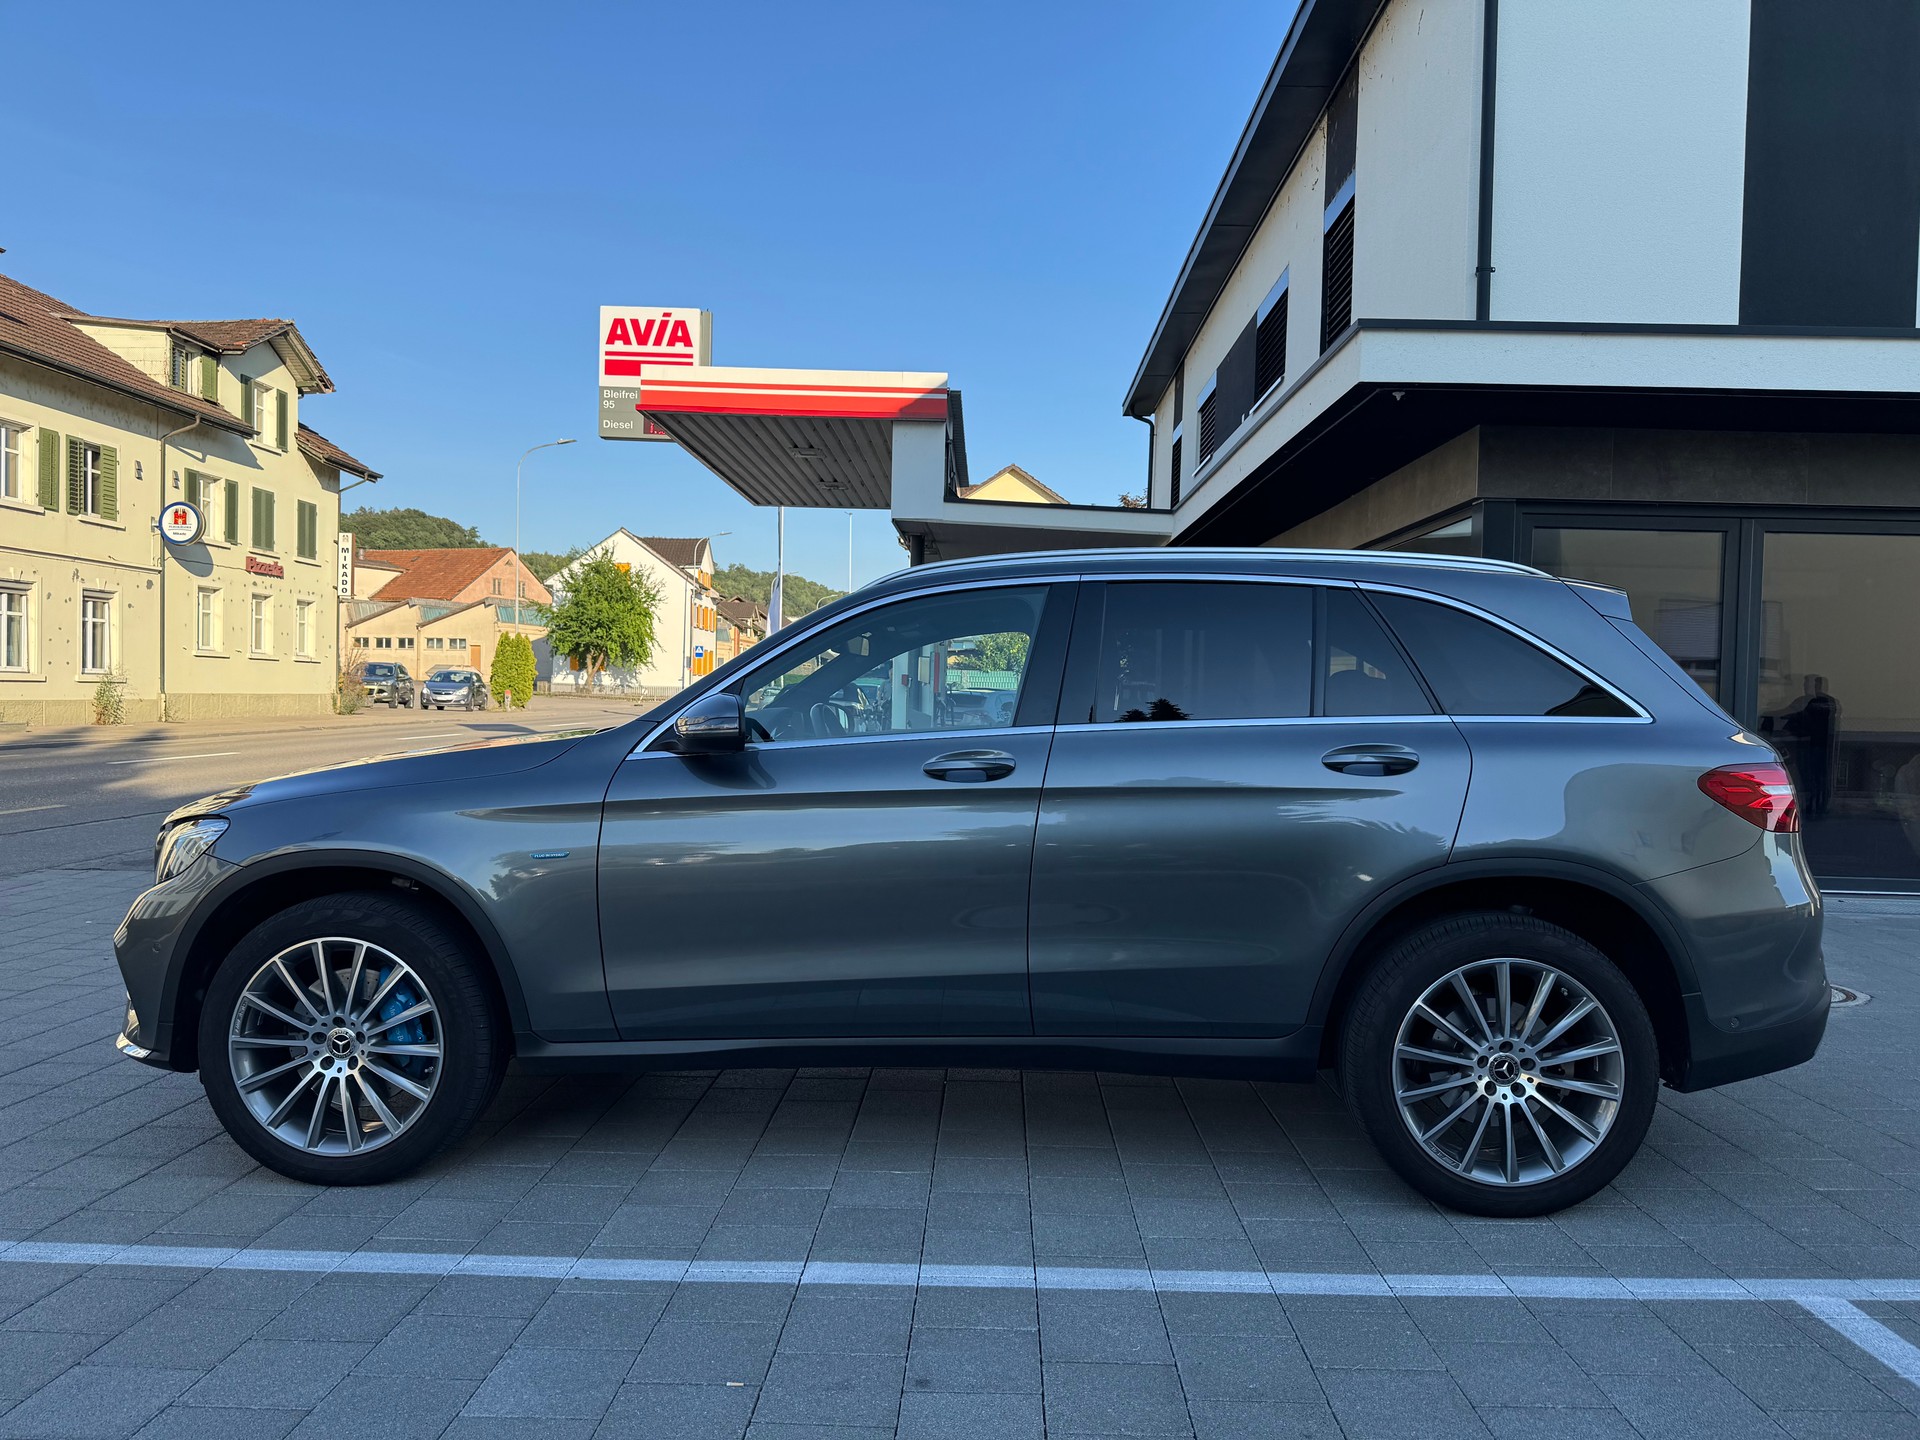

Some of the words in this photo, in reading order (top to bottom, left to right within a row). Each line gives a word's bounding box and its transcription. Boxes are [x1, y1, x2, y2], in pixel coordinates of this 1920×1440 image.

[605, 312, 694, 348] AVIA
[603, 389, 638, 399] Bleifrei
[603, 400, 615, 409] 95
[603, 420, 633, 429] Diesel
[341, 547, 350, 594] MIKADO
